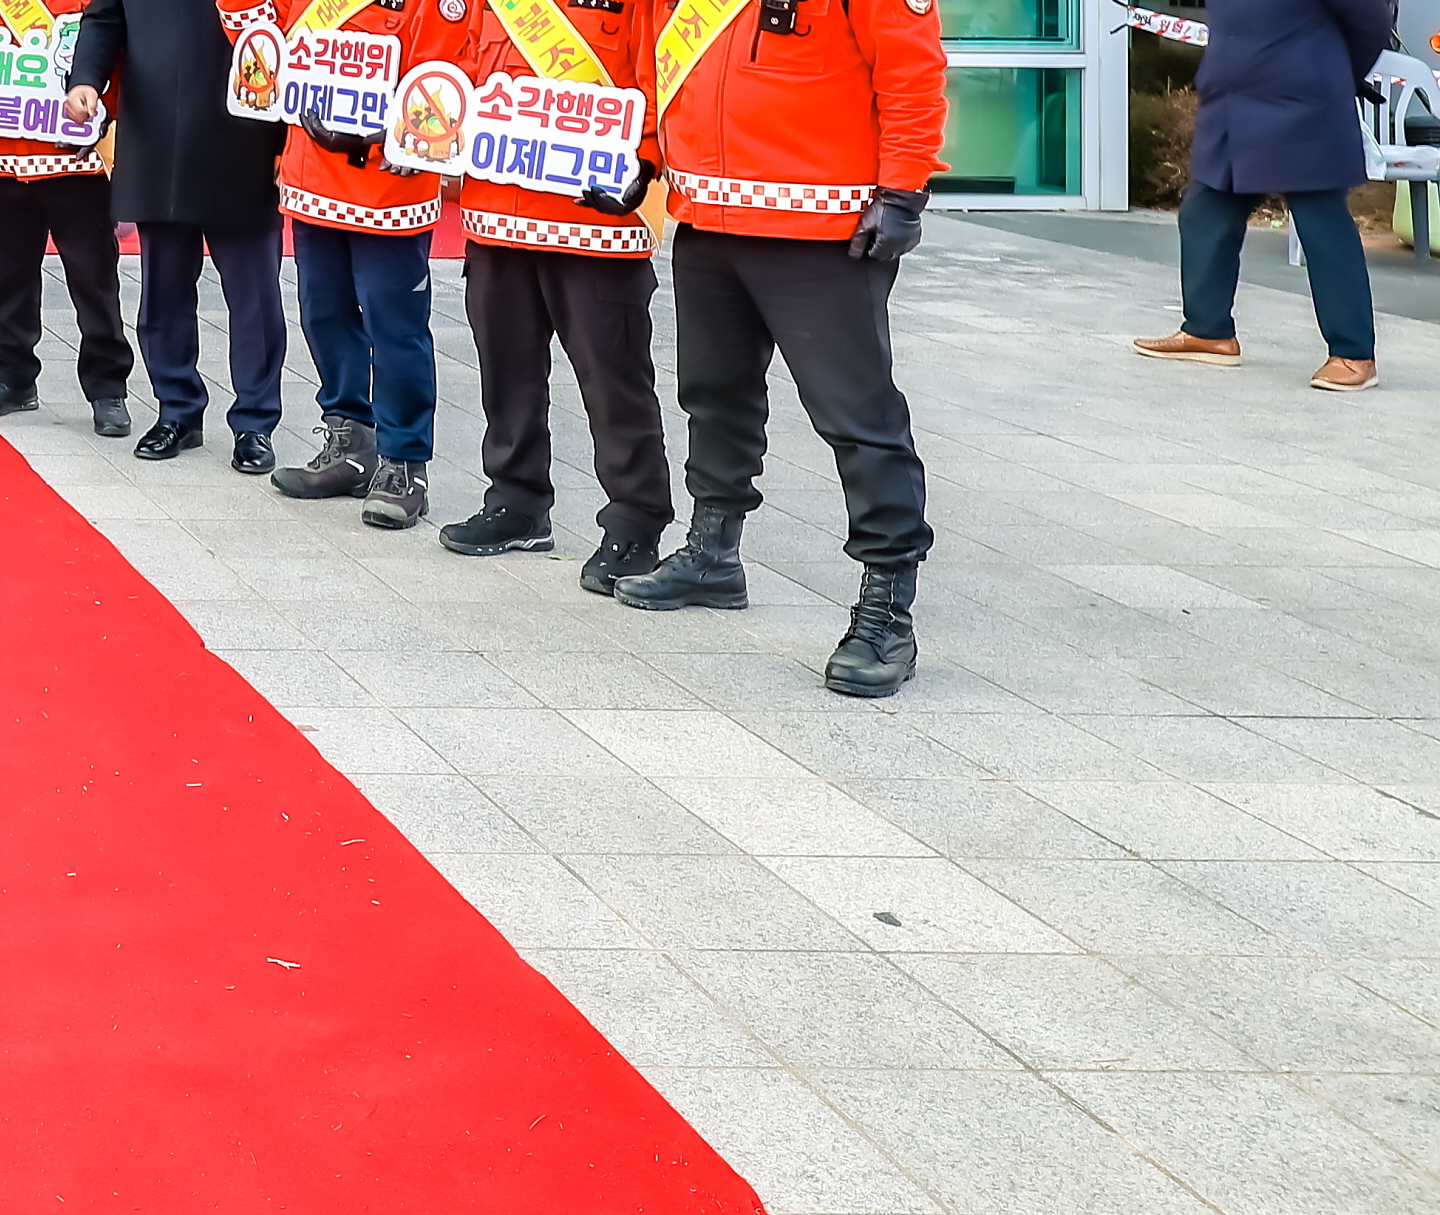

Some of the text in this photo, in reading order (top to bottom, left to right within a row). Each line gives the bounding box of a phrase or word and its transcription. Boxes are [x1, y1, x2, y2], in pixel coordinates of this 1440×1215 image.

[287, 36, 392, 82] 소각행위
[284, 81, 389, 130] 이제그만
[477, 82, 635, 141] 소각행위
[471, 131, 629, 195] 이제그만
